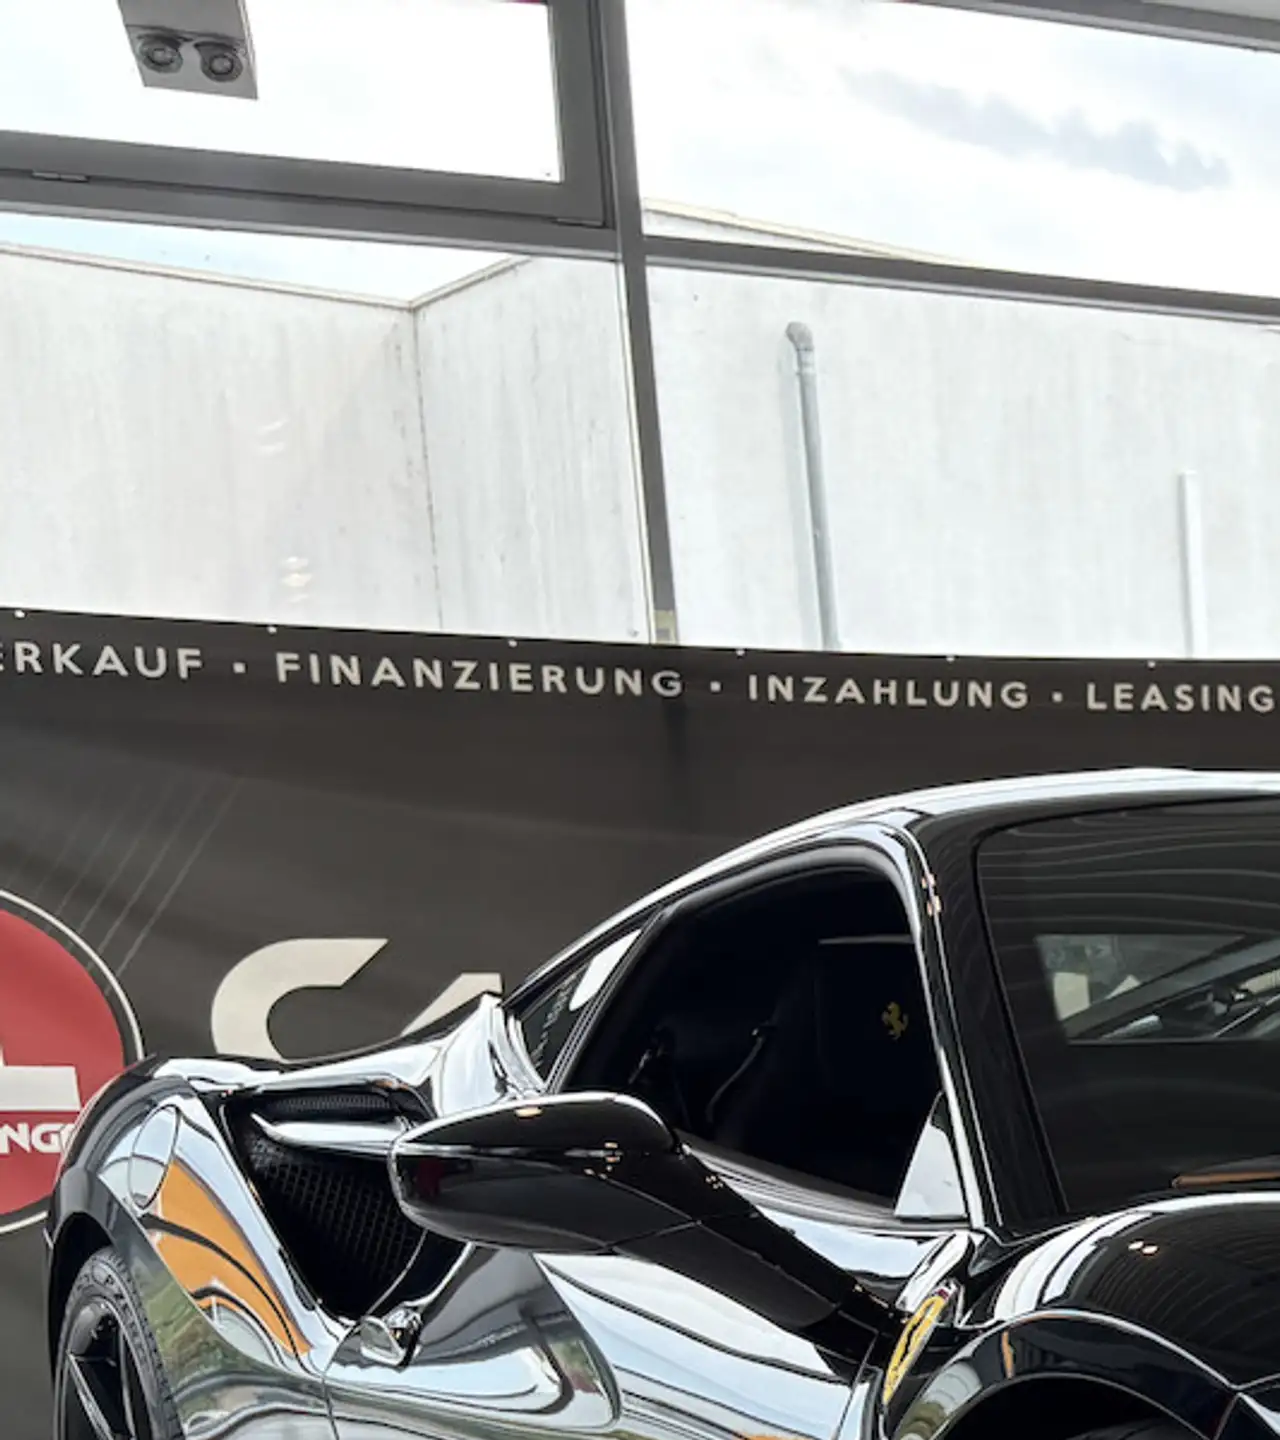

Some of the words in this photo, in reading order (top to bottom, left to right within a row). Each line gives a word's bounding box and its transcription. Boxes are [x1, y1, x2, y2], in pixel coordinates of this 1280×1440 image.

[0, 641, 202, 679] RKAUF
[275, 652, 682, 697] FINANZIERUNG
[749, 674, 1028, 709] INZAHLUNG
[1087, 683, 1274, 713] LEASING
